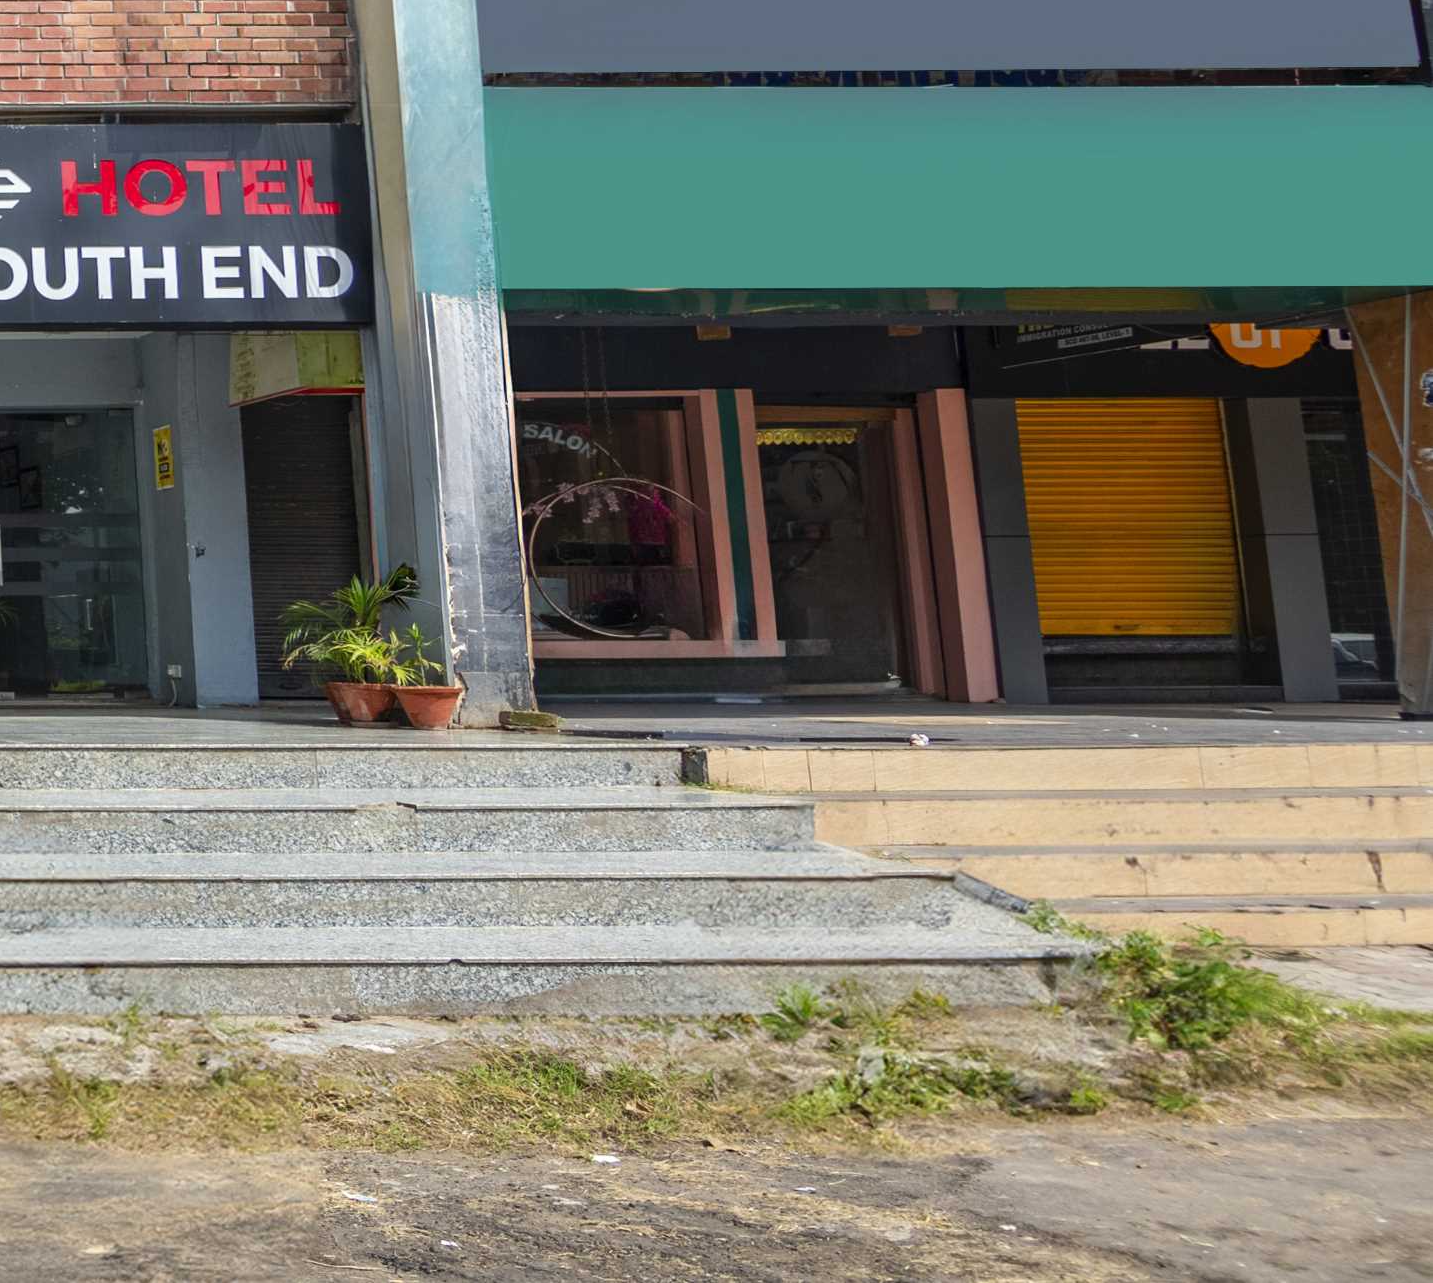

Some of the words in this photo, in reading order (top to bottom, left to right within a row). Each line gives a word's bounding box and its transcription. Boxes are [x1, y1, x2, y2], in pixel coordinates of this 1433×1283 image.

[61, 158, 342, 217] HOTEL
[200, 245, 354, 300] END
[523, 422, 596, 459] SALON
